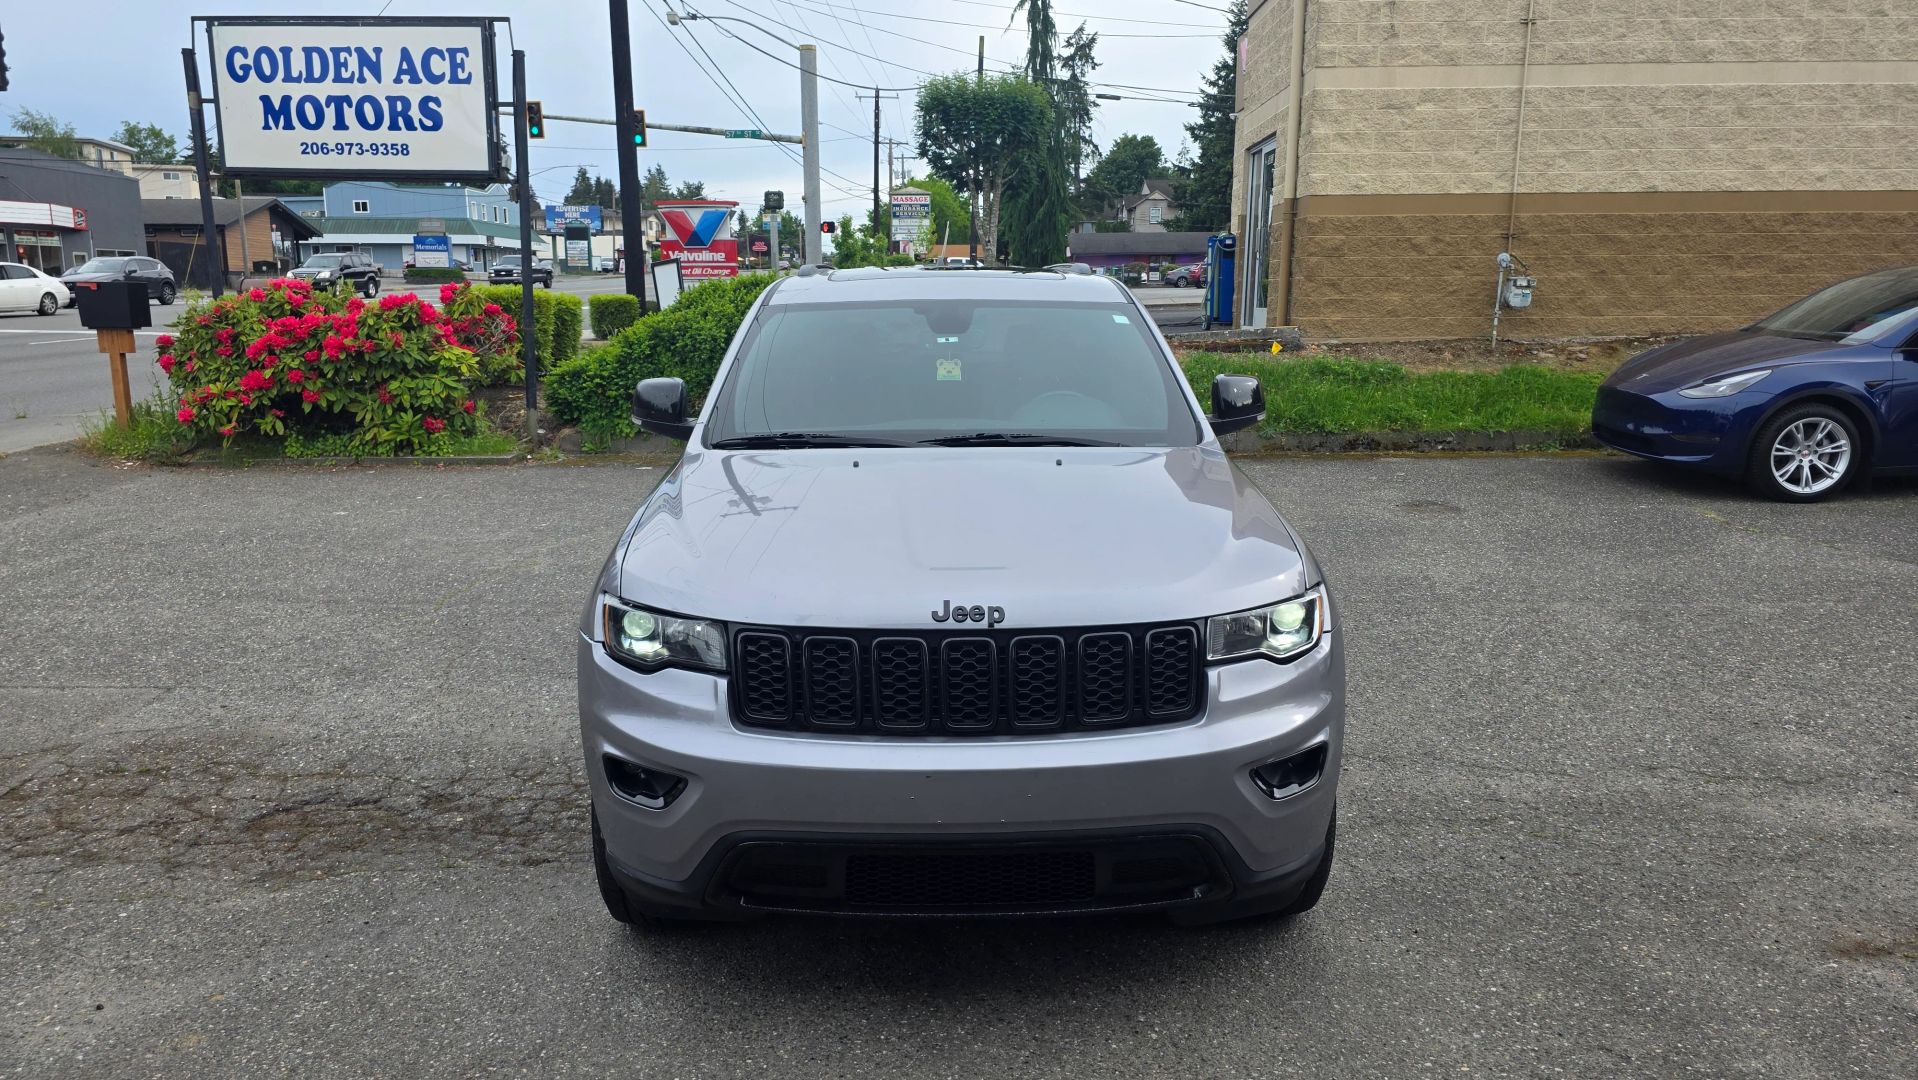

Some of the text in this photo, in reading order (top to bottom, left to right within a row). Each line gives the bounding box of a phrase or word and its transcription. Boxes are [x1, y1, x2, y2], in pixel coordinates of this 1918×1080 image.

[225, 45, 473, 85] GOLDEN ACE
[258, 94, 444, 132] MOTORS
[743, 130, 752, 138] ST
[300, 141, 410, 156] 206-973-9358
[555, 205, 590, 213] ADVERTISE
[668, 250, 726, 262] Valvoline
[691, 267, 703, 275] Oil
[702, 267, 732, 276] Change
[931, 599, 1006, 629] Jeep
